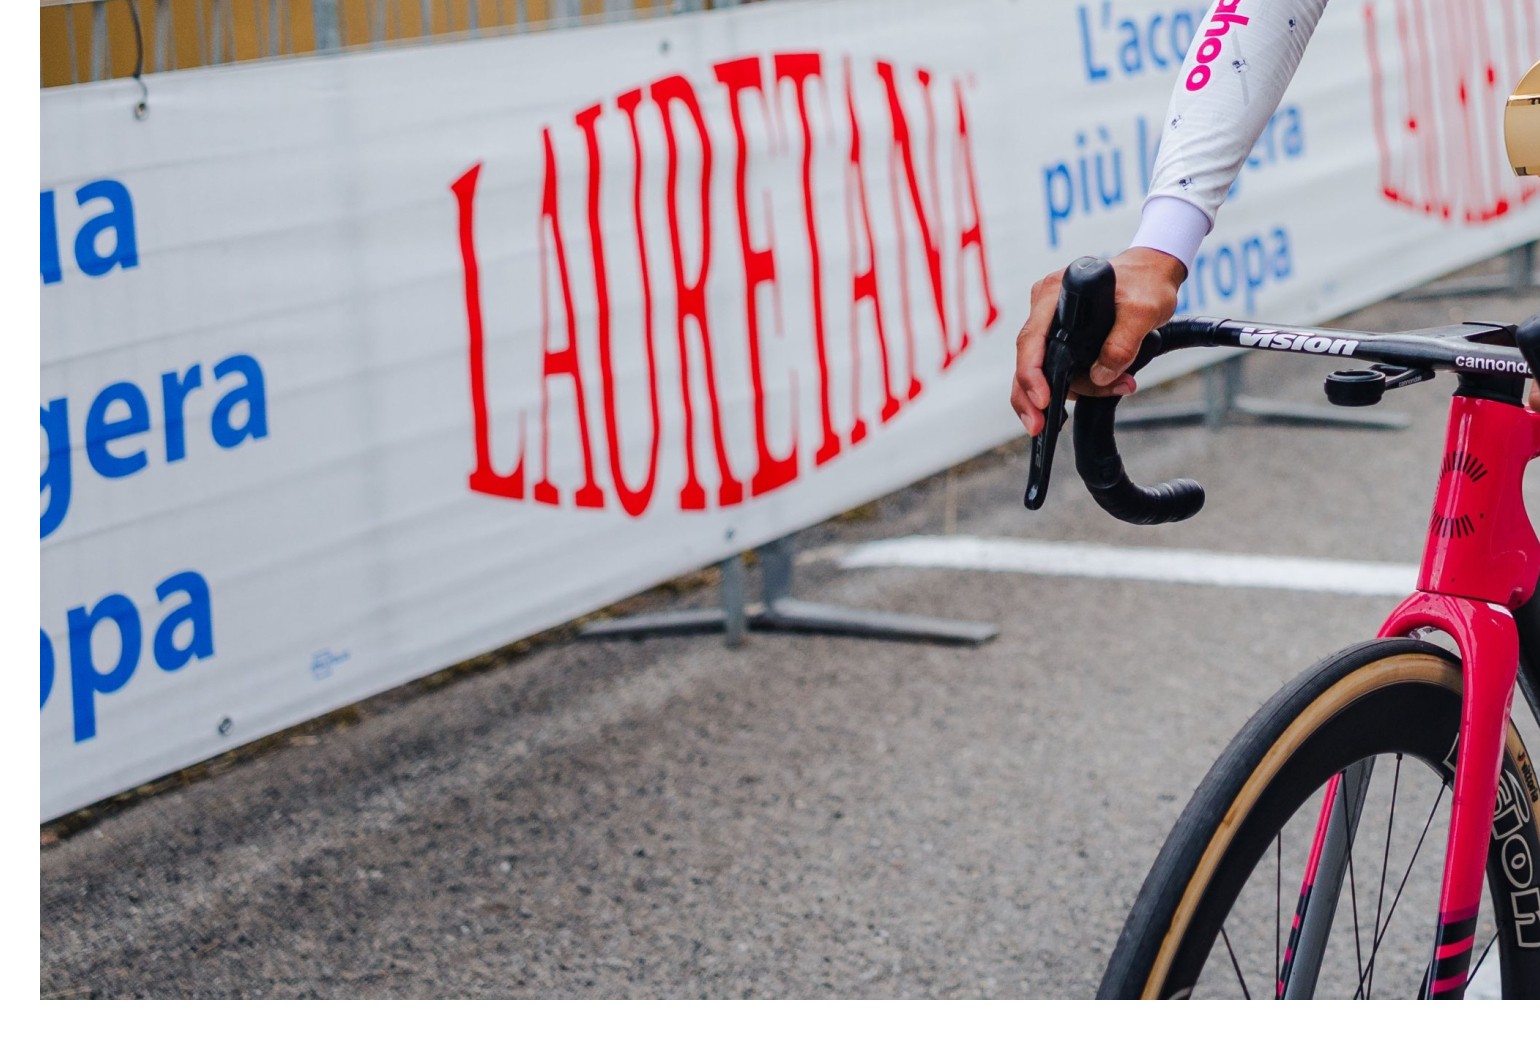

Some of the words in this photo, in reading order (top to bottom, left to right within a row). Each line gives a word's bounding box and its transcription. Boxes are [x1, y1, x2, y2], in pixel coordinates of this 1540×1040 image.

[450, 50, 1001, 517] LAURETANA
[1455, 353, 1533, 375] cannond
[1521, 763, 1538, 804] vittoria
